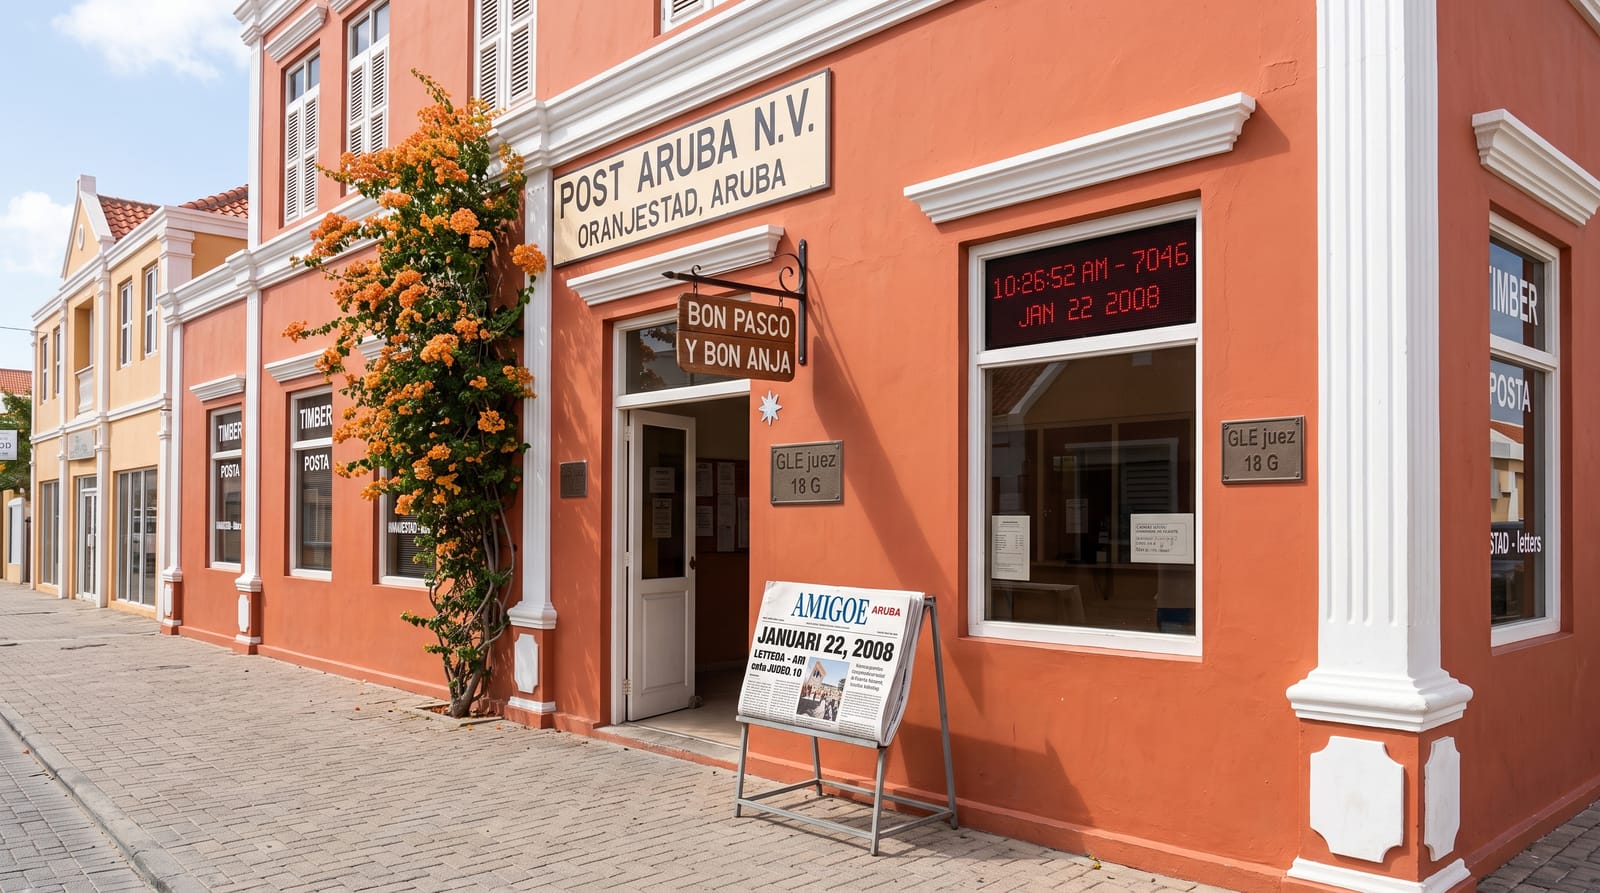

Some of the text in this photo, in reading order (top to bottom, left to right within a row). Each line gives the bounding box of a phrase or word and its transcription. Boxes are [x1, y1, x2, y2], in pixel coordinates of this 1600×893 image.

[560, 87, 814, 219] POST ARUBA N.V.
[578, 158, 786, 249] ORANJESTAD, ARUBA
[992, 263, 1076, 299] 10:26:52
[1081, 257, 1108, 284] AM
[1132, 241, 1189, 274] 7046
[688, 301, 790, 338] BON PASCO
[1018, 285, 1160, 328] JAN 22 2008
[685, 338, 791, 374] Y BON ANJA
[1489, 372, 1531, 413] POSTA
[218, 421, 242, 443] TIMBER
[300, 404, 333, 430] TIMBER
[1228, 427, 1296, 450] GLE juez
[220, 464, 240, 480] POSTA
[304, 454, 330, 472] POSTA
[776, 451, 836, 473] GLE juez
[1244, 454, 1279, 472] 18 G
[791, 477, 821, 495] 18 G
[1517, 529, 1542, 553] letters
[790, 592, 901, 626] AMIGOE ARUBA
[757, 626, 895, 662] JANUARI 22, 2008
